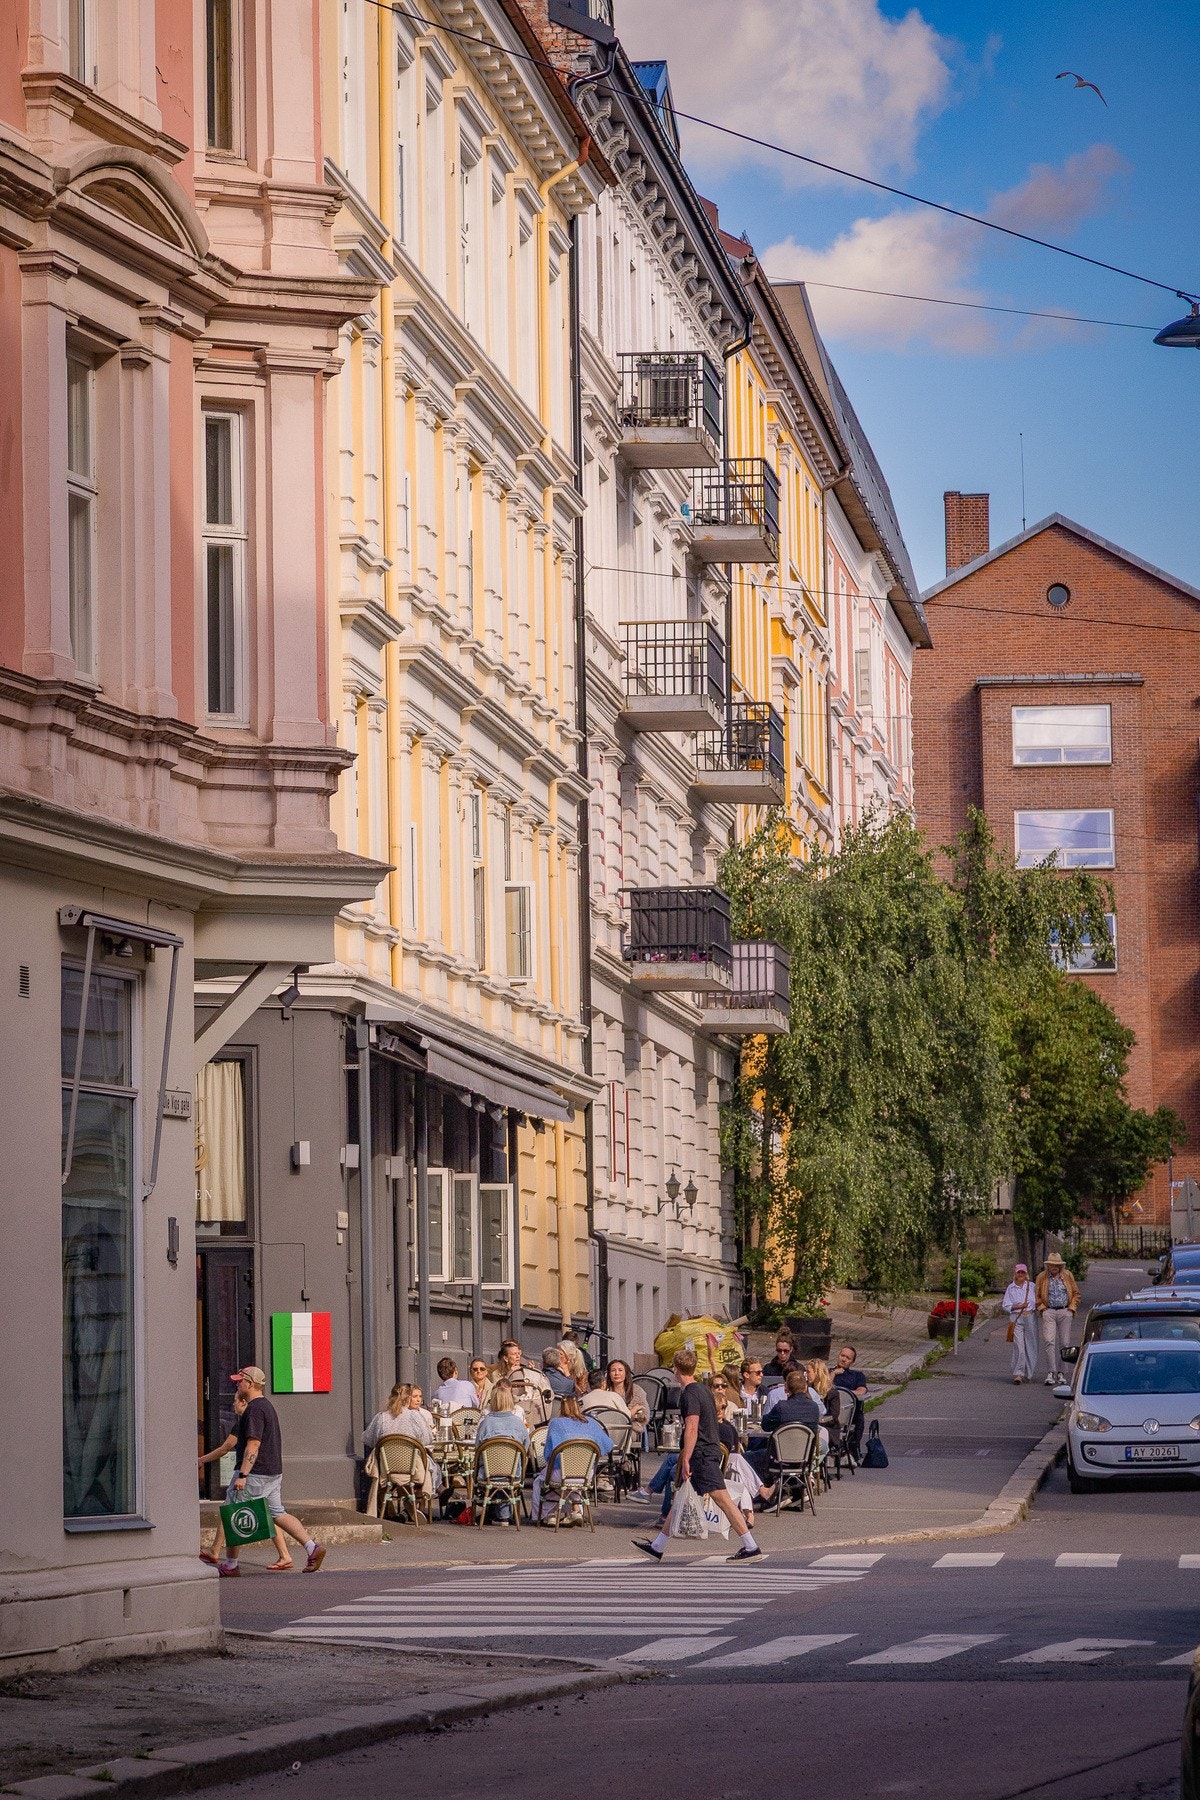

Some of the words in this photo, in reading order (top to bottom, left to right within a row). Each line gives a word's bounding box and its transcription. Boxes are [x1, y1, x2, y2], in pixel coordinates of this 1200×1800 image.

[181, 1098, 190, 1114] gate
[1134, 1448, 1145, 1456] AY
[1150, 1447, 1176, 1456] 20261
